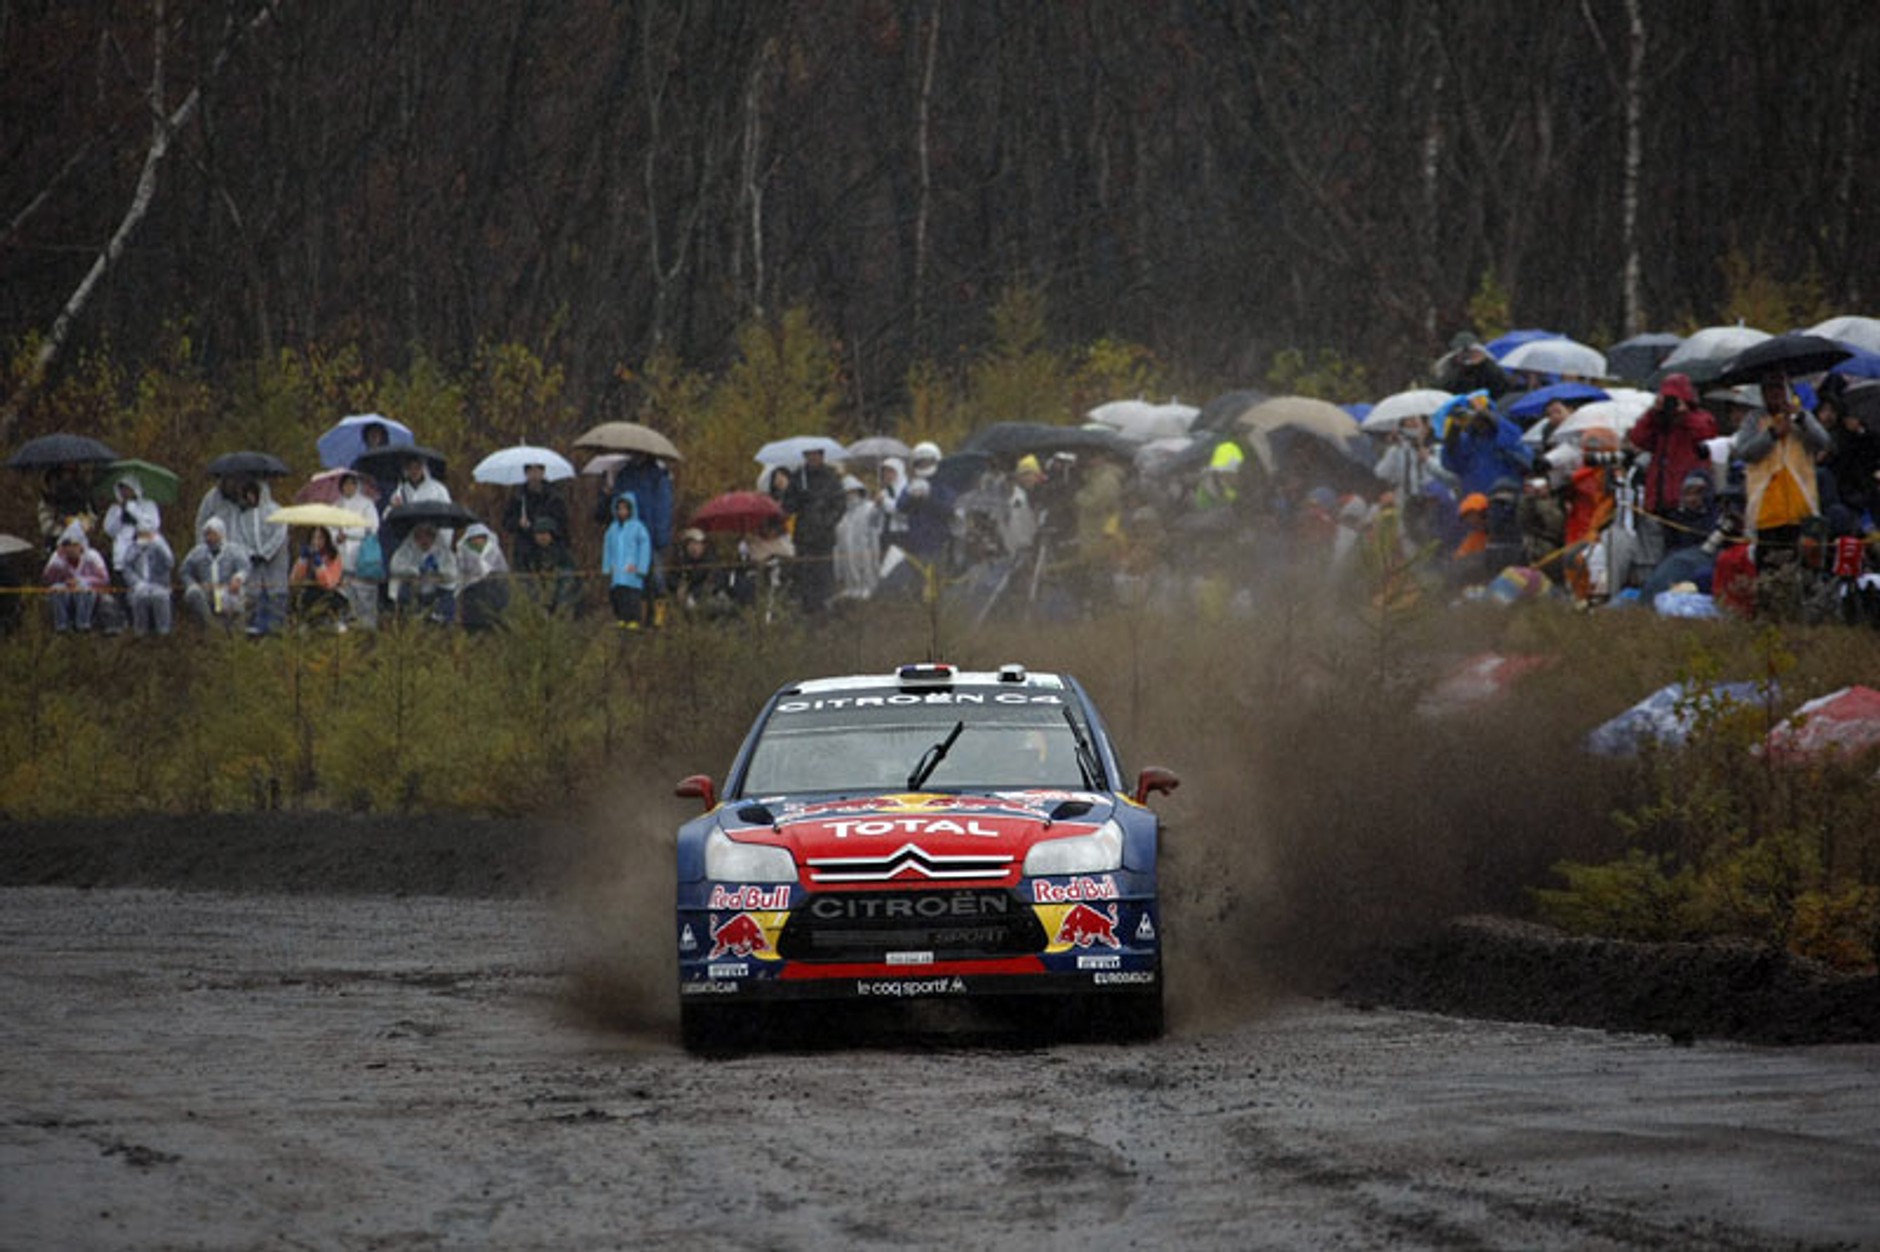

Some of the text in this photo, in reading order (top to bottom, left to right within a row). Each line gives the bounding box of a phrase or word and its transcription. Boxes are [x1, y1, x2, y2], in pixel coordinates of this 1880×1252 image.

[777, 692, 1063, 712] CITROËN C4
[823, 820, 998, 838] TOTAL
[746, 886, 790, 909] Bull
[1034, 877, 1081, 902] Red
[812, 891, 1007, 918] CITROËN
[857, 978, 949, 997] le coq sportif
